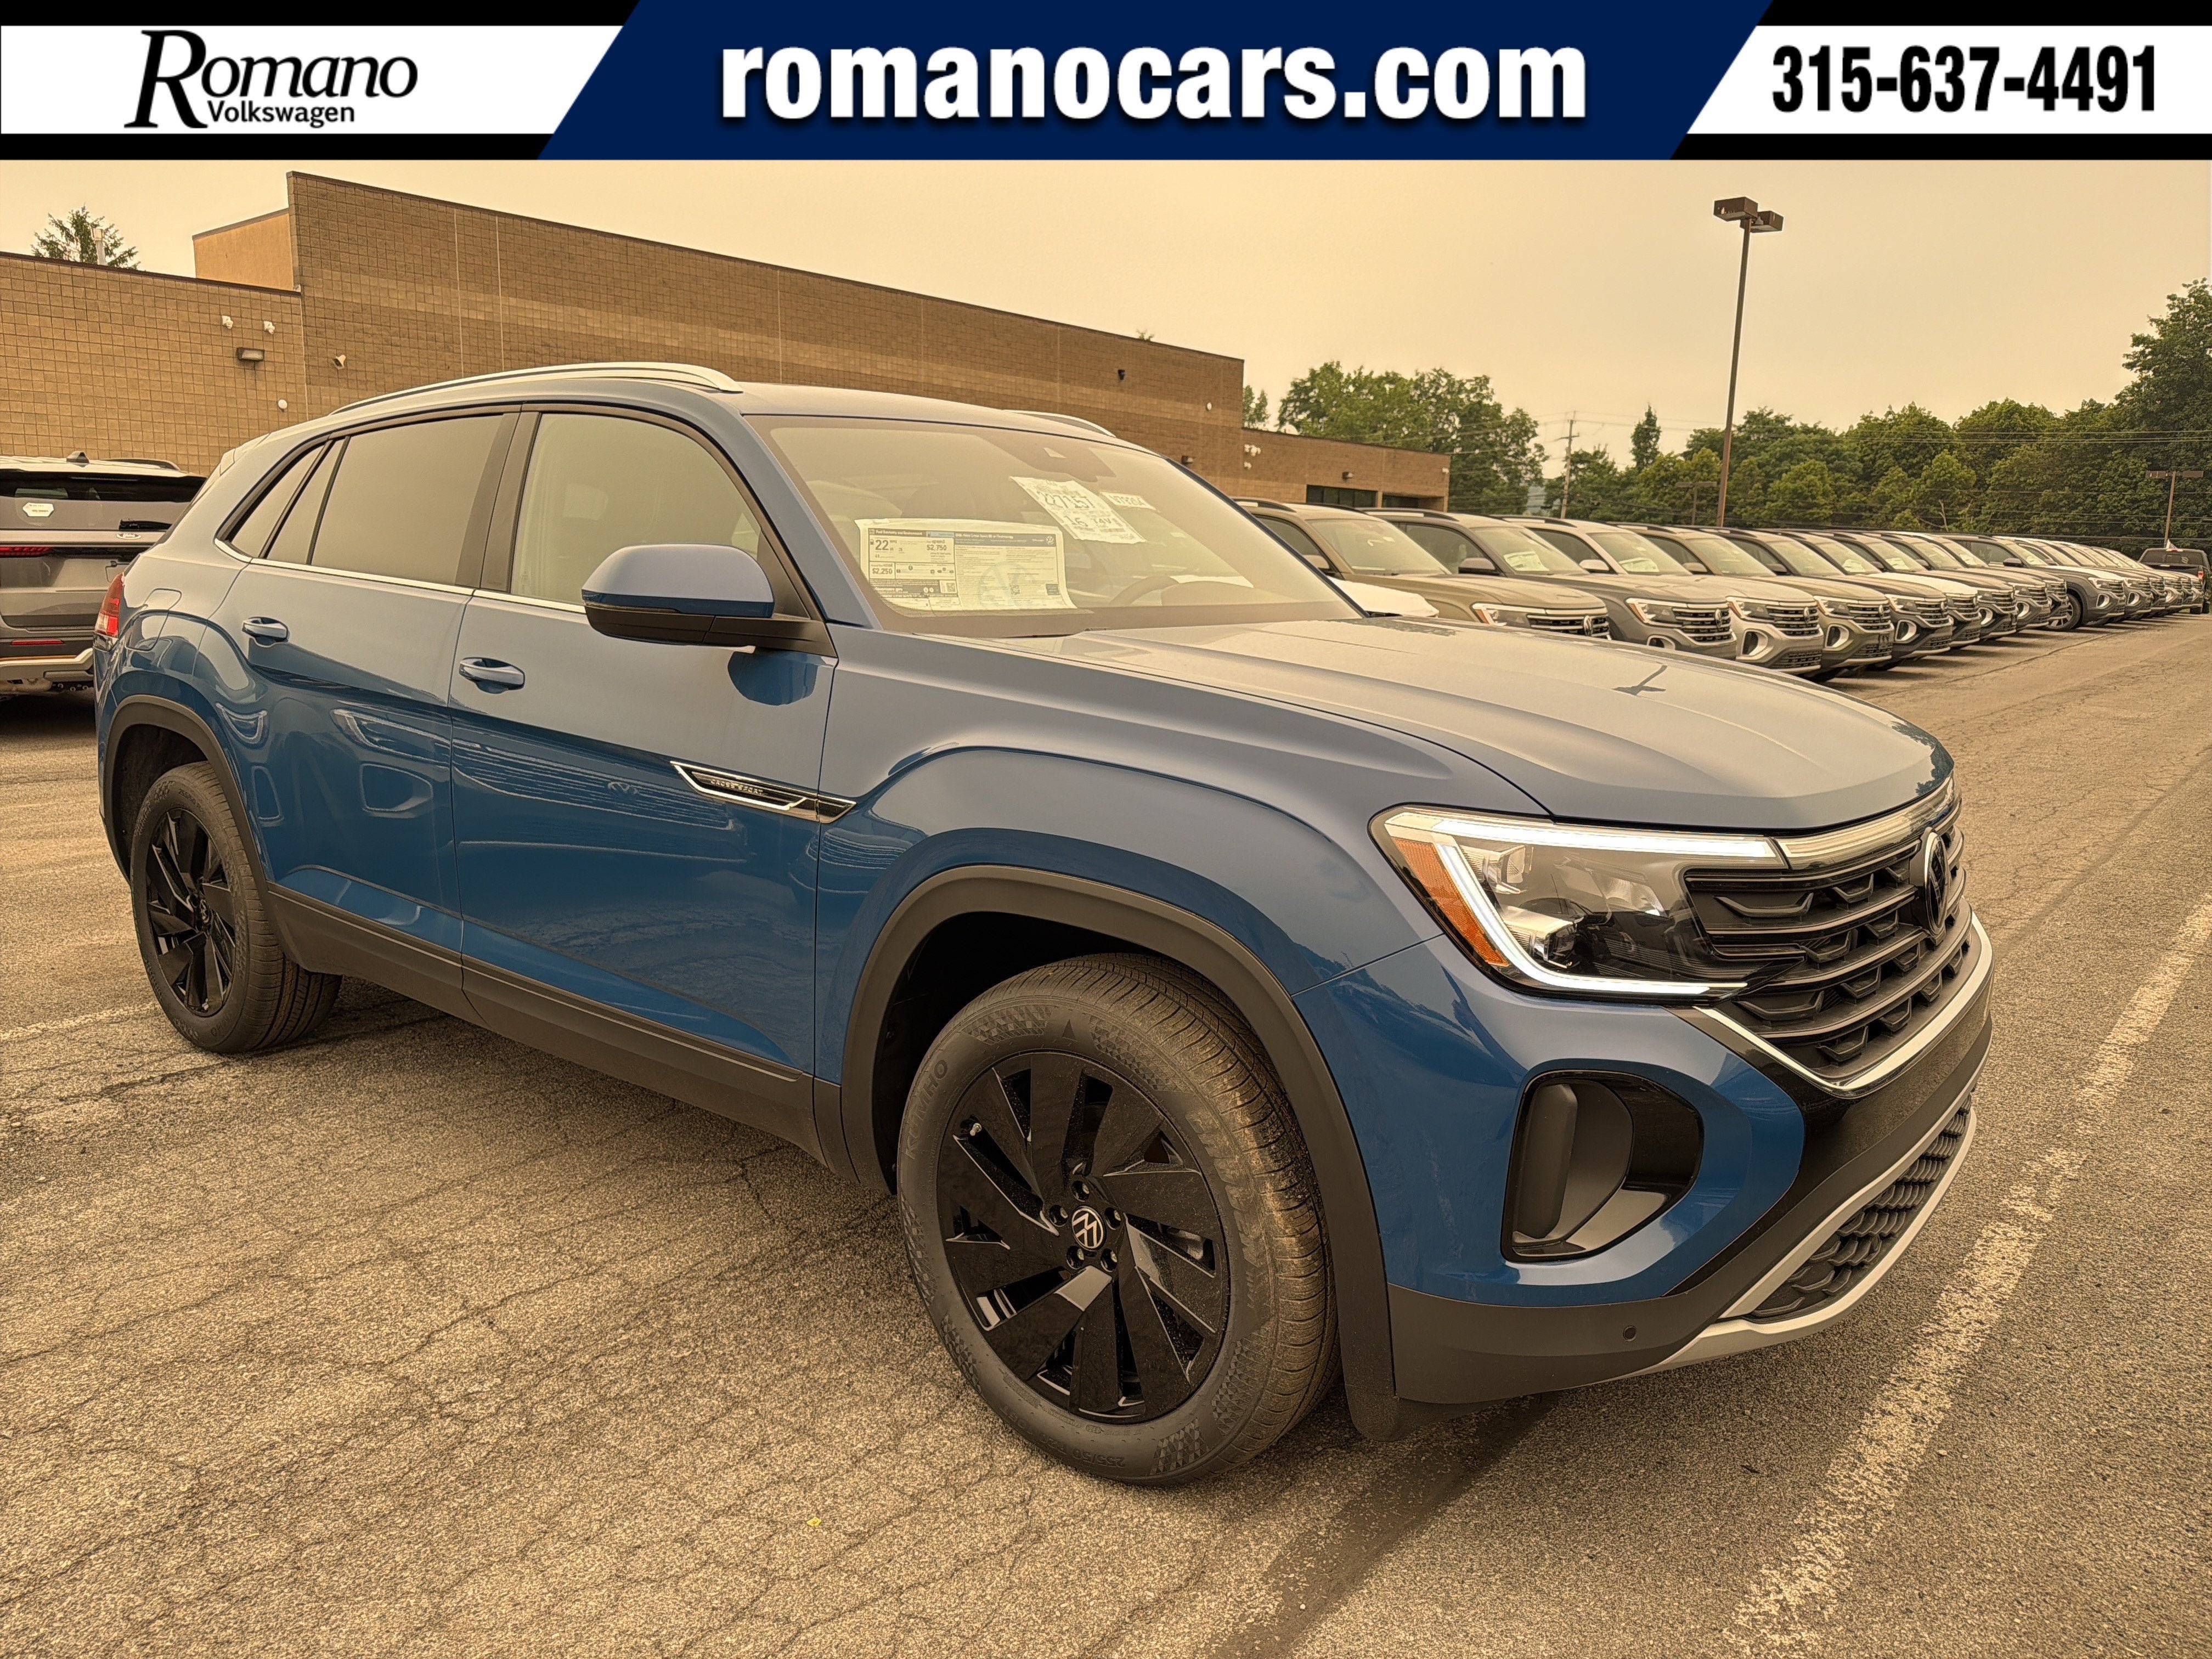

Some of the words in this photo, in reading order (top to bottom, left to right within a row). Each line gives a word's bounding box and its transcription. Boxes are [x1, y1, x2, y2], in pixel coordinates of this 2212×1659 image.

[875, 539, 889, 551] 22
[710, 778, 736, 789] CROSS
[738, 784, 764, 795] SPORT
[1072, 1448, 1126, 1469] 255/50
